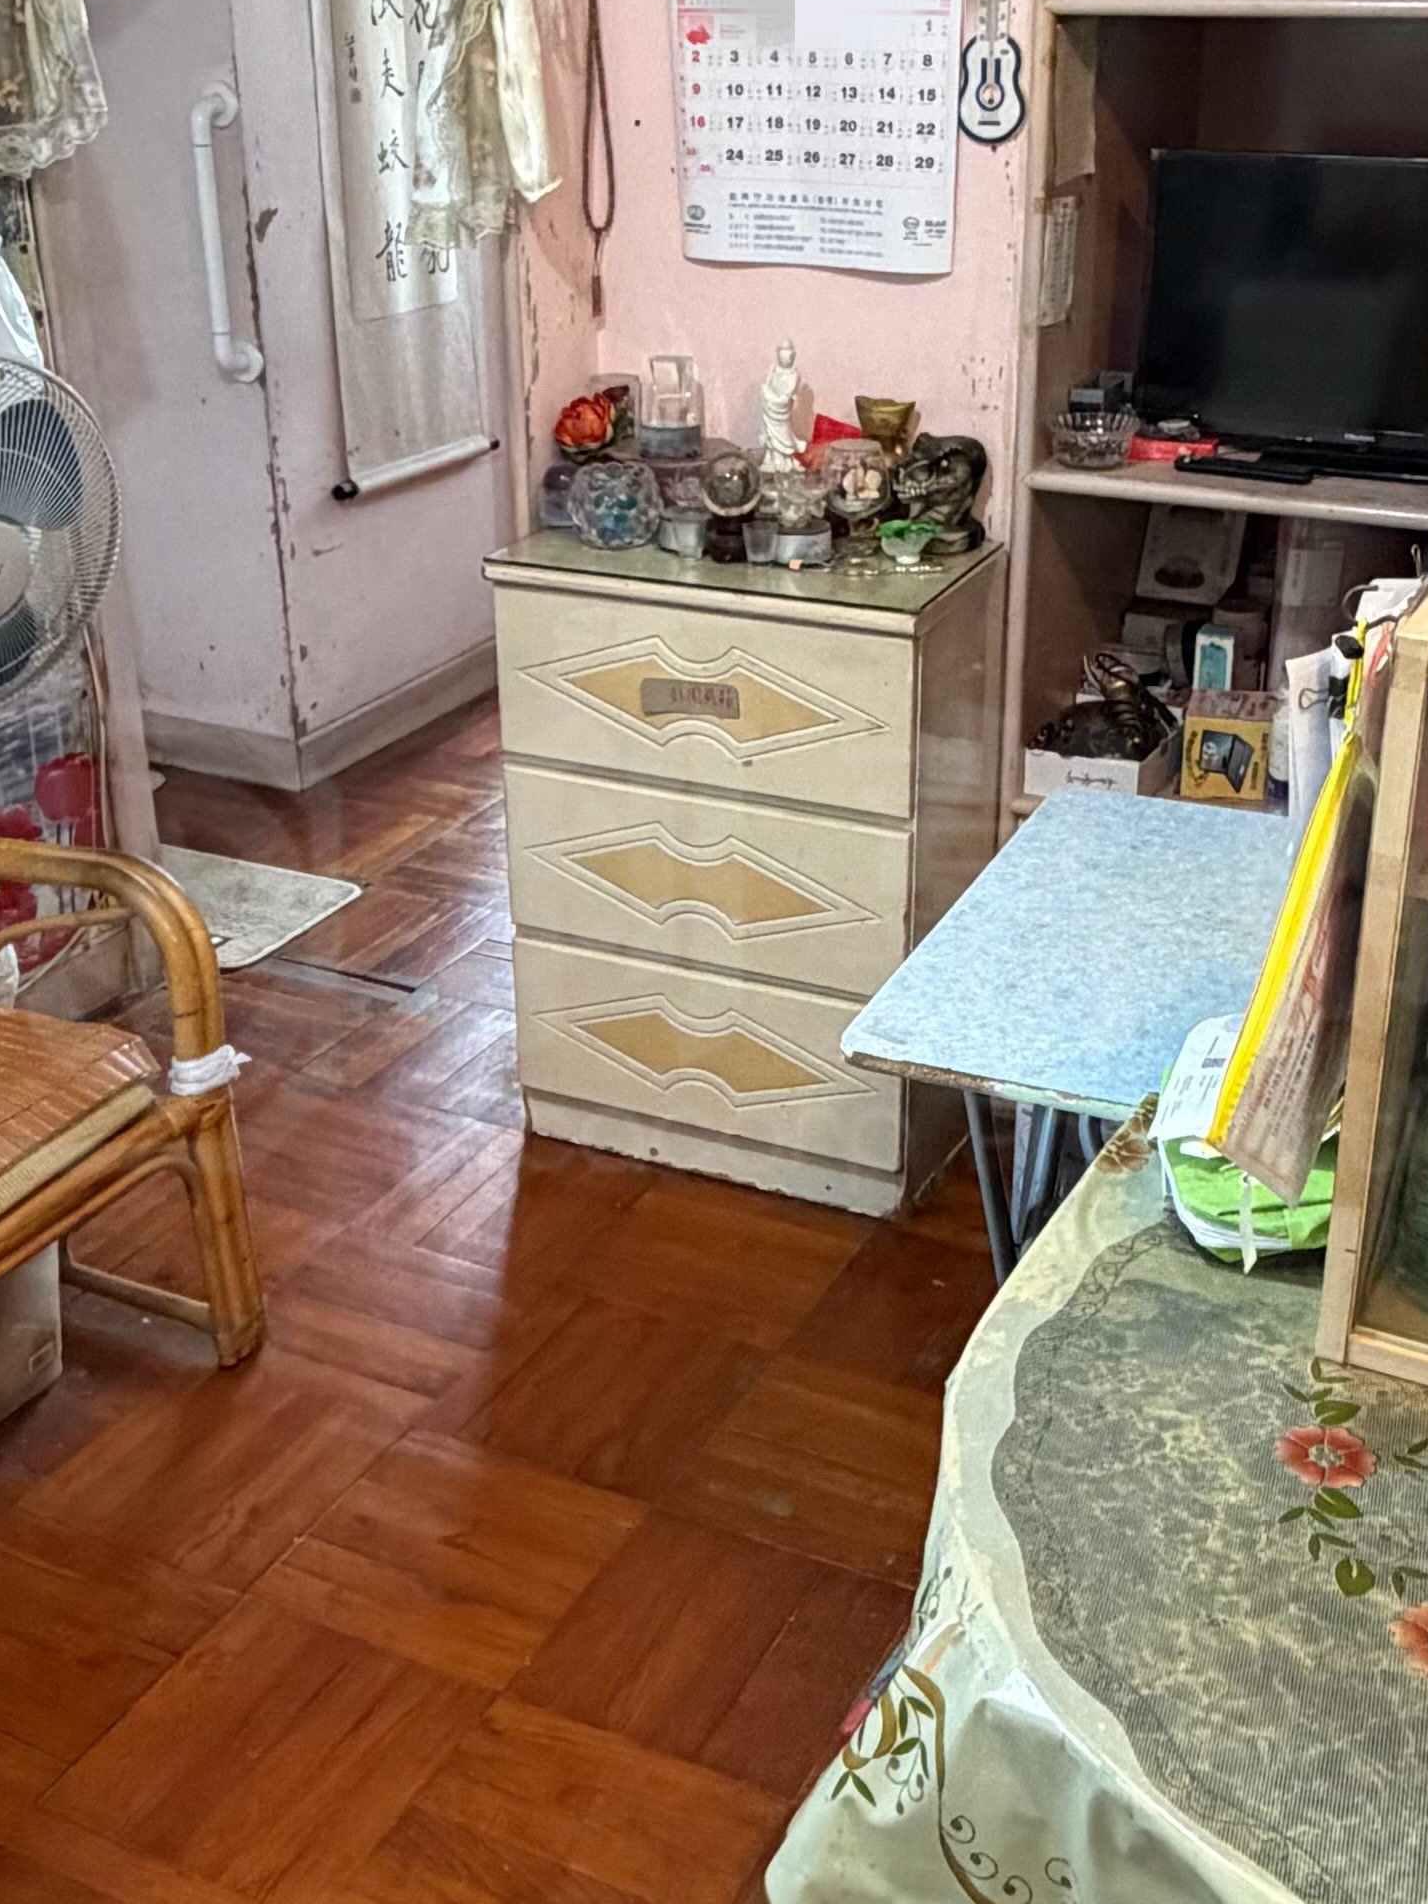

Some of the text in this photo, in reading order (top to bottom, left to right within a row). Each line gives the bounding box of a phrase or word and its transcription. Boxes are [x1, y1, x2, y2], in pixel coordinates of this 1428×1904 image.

[692, 50, 933, 67] 2 3 4 5 6 7 8
[726, 84, 744, 96] 10
[766, 84, 783, 96] 11
[805, 86, 821, 97] 12
[841, 87, 857, 100] 13
[878, 87, 896, 100] 14
[918, 89, 936, 102] 15
[726, 117, 744, 129] 17
[766, 116, 784, 129] 18
[805, 118, 821, 131] 19
[840, 120, 857, 133] 20
[877, 120, 894, 134] 21
[916, 122, 936, 136] 22
[726, 149, 744, 161] 24
[765, 150, 784, 162] 25
[803, 151, 821, 164] 26
[839, 153, 856, 166] 27
[876, 154, 894, 167] 28
[915, 157, 935, 169] 29
